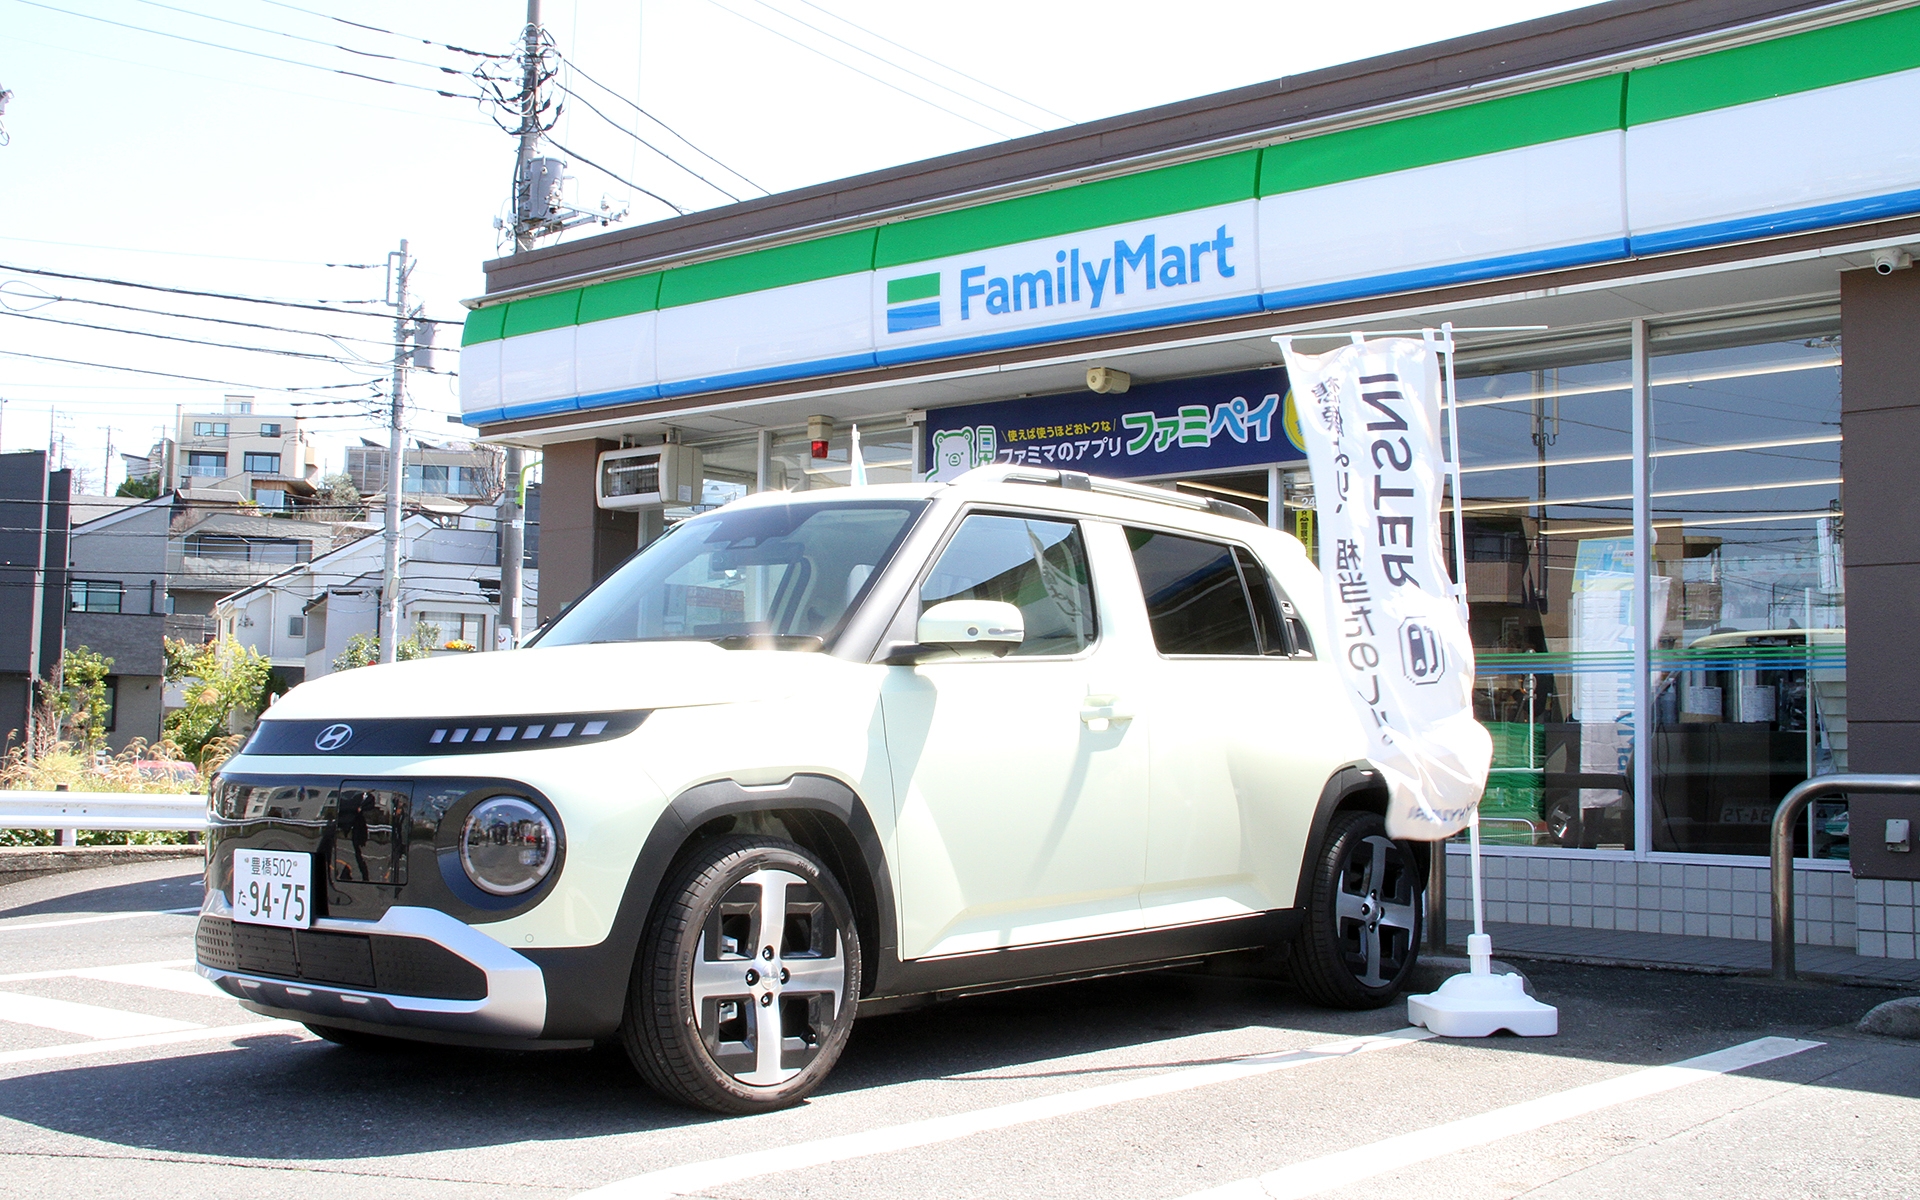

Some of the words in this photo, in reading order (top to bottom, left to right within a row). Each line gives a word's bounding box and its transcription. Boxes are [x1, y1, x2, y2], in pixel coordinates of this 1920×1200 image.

[960, 223, 1235, 320] FamilyMart
[1007, 420, 1111, 442] 使えば使うほどおトクな
[1123, 395, 1278, 454] ファミペイ
[1000, 437, 1122, 466] ファミマのアプリ
[237, 889, 247, 906] た
[249, 881, 306, 922] 94-75
